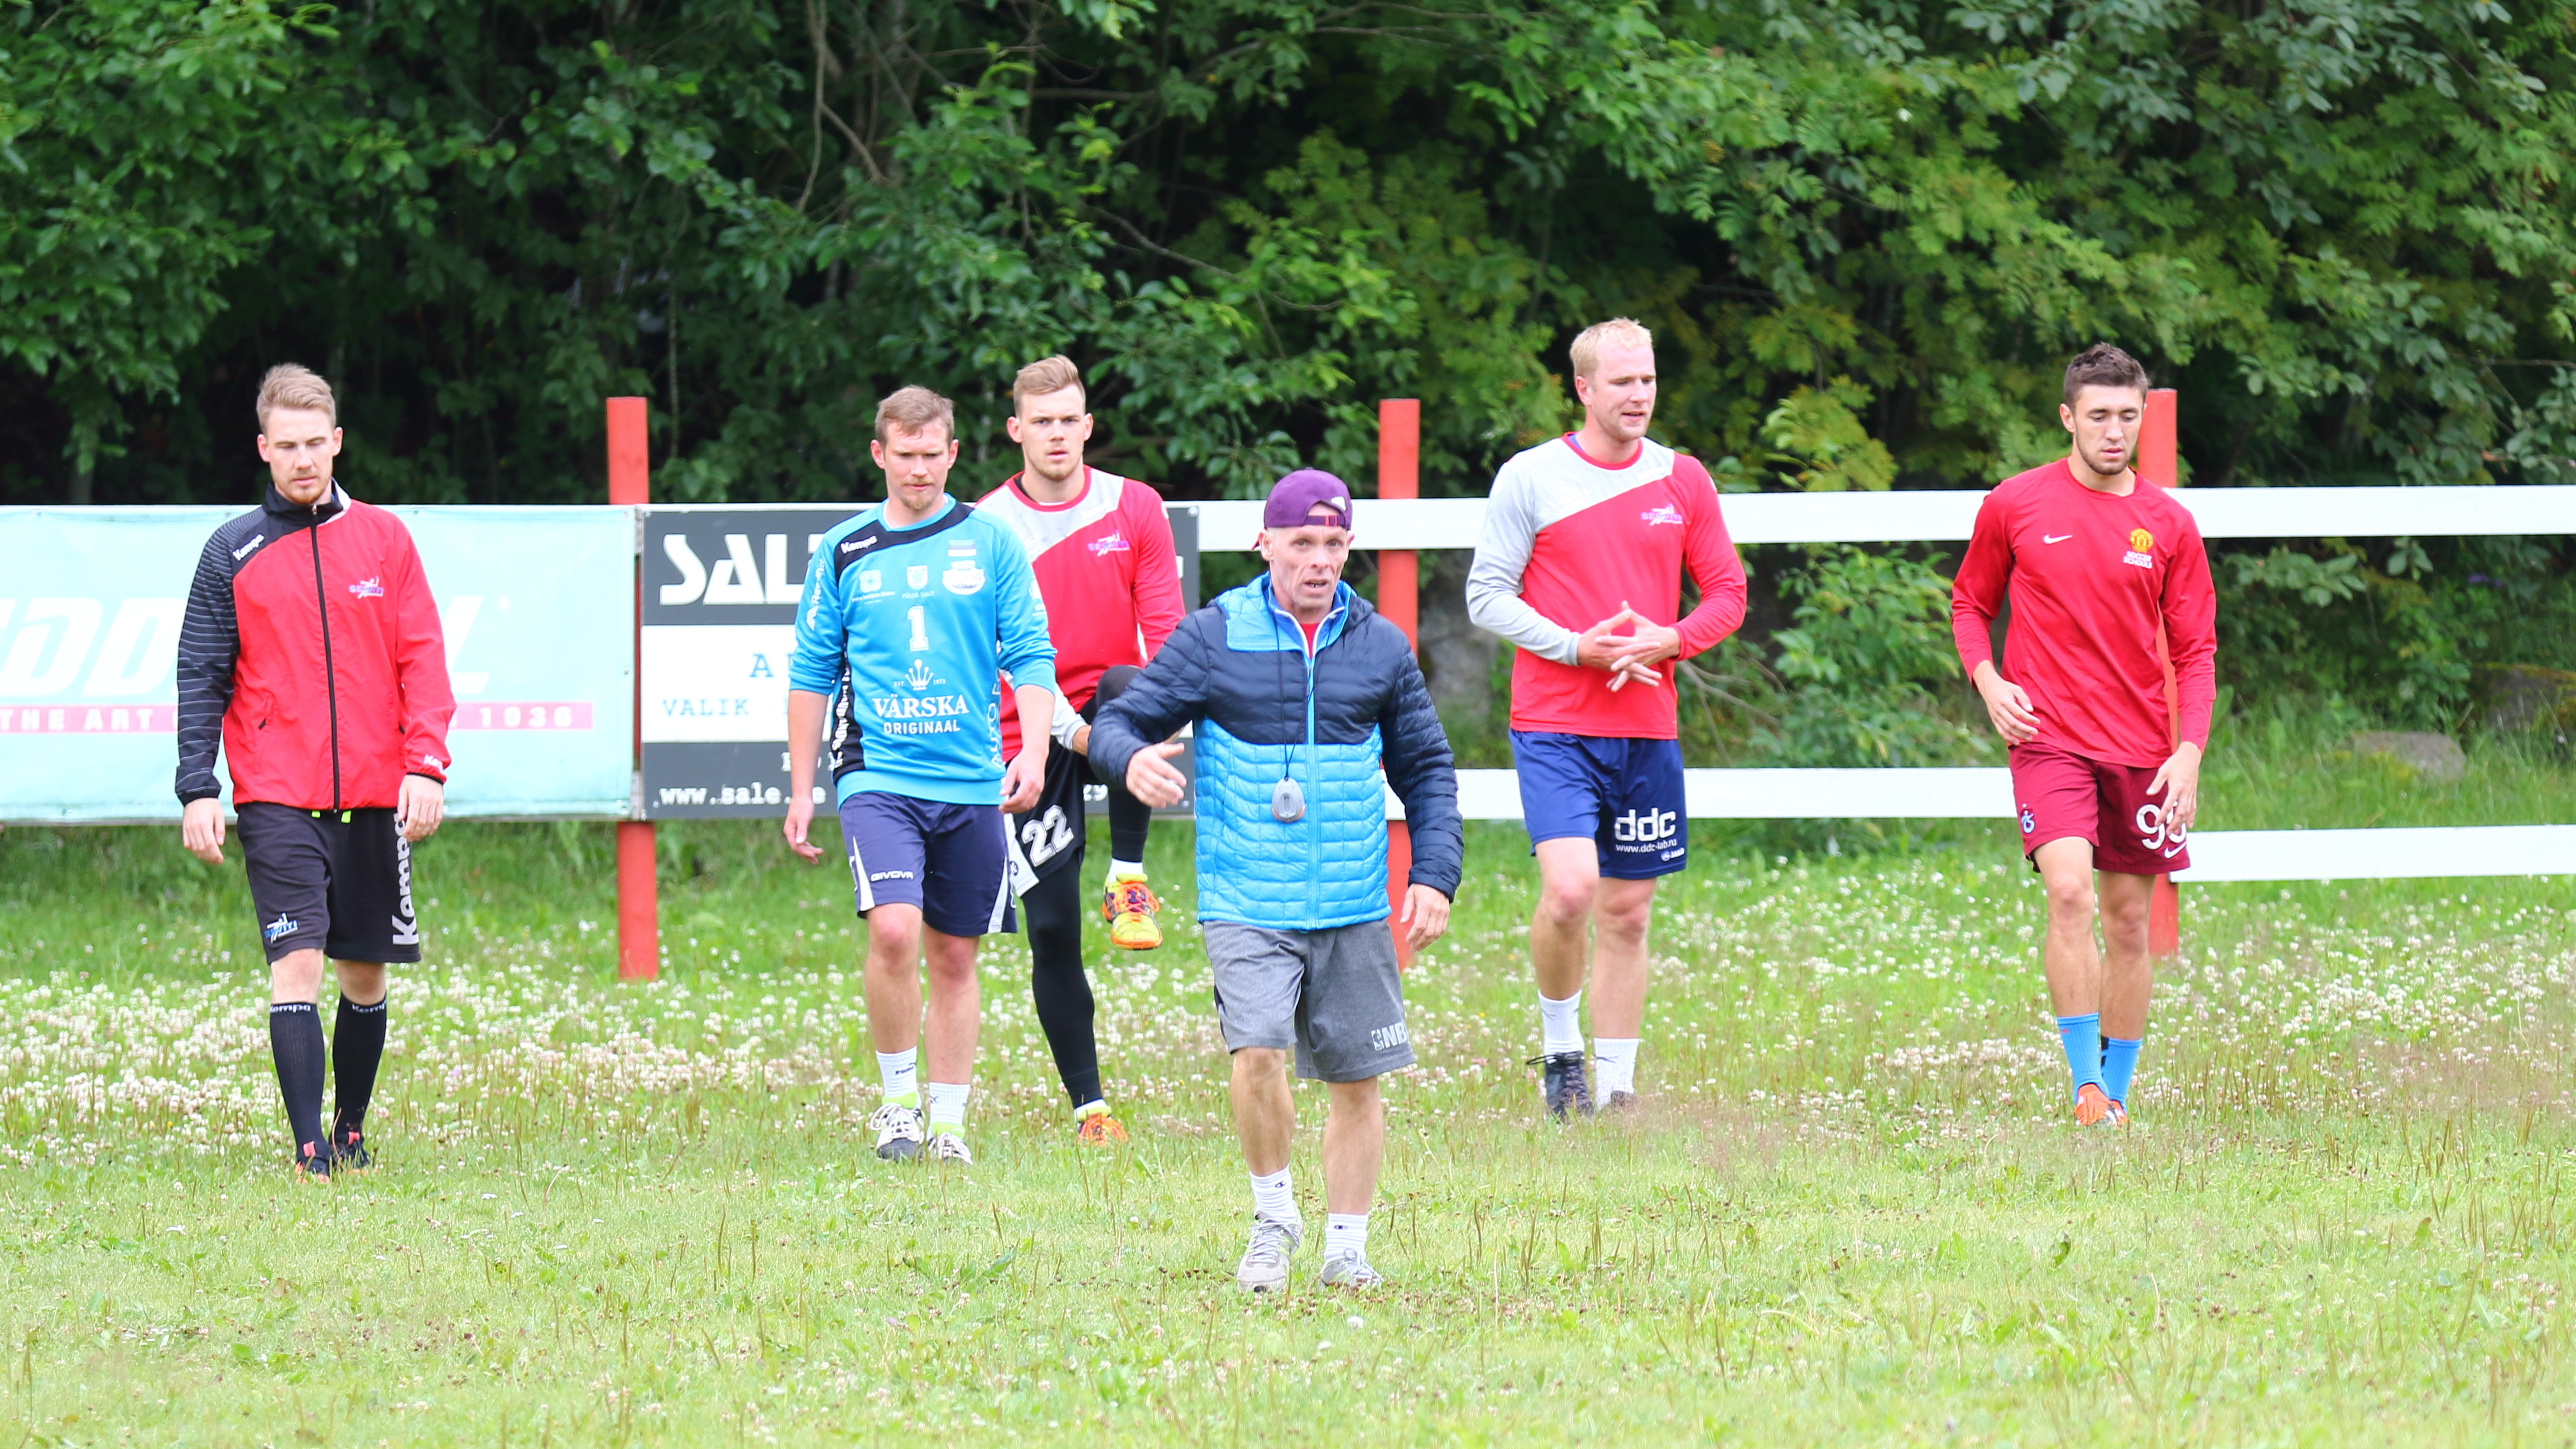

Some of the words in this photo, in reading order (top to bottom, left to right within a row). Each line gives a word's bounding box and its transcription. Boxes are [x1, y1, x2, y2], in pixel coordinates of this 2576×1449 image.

[232, 533, 265, 561] Kempa
[840, 535, 878, 554] Kempa
[2126, 551, 2152, 562] SOCCER
[660, 533, 824, 605] SAL
[2123, 556, 2152, 569] SCHOOLS
[907, 605, 929, 652] 1
[662, 699, 749, 715] VALIK
[872, 694, 969, 718] VÄRSKA
[84, 708, 153, 731] ART
[479, 706, 572, 728] 1936
[883, 719, 960, 734] ORIGINAAL
[659, 782, 827, 806] www.sale.e
[1021, 804, 1075, 867] 22
[1614, 807, 1676, 841] ddc
[1615, 838, 1678, 853] www.ddc-lab.ru
[871, 870, 914, 882] GIVOVA
